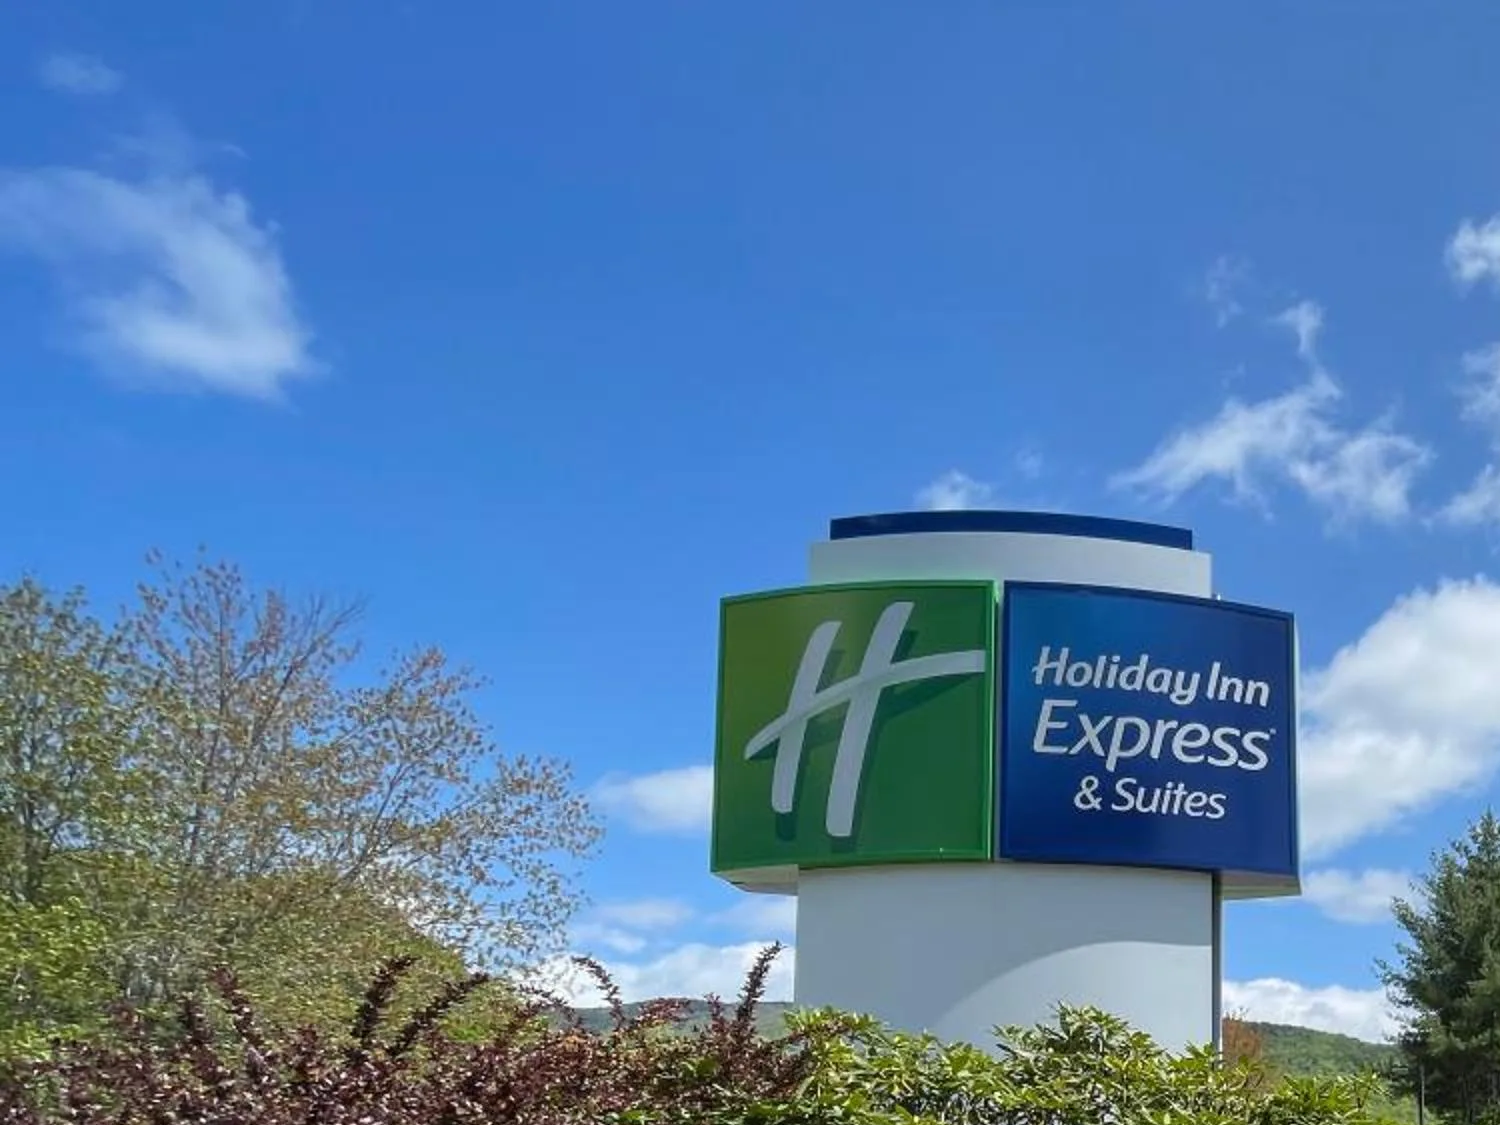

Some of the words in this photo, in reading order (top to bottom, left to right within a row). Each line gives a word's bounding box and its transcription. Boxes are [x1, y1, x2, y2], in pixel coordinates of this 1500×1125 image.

[1031, 646, 1200, 705] Holiday
[1206, 661, 1270, 707] Inn
[744, 601, 986, 837] H
[1033, 699, 1270, 772] Express
[1073, 775, 1102, 811] &
[1111, 777, 1227, 819] Suites
